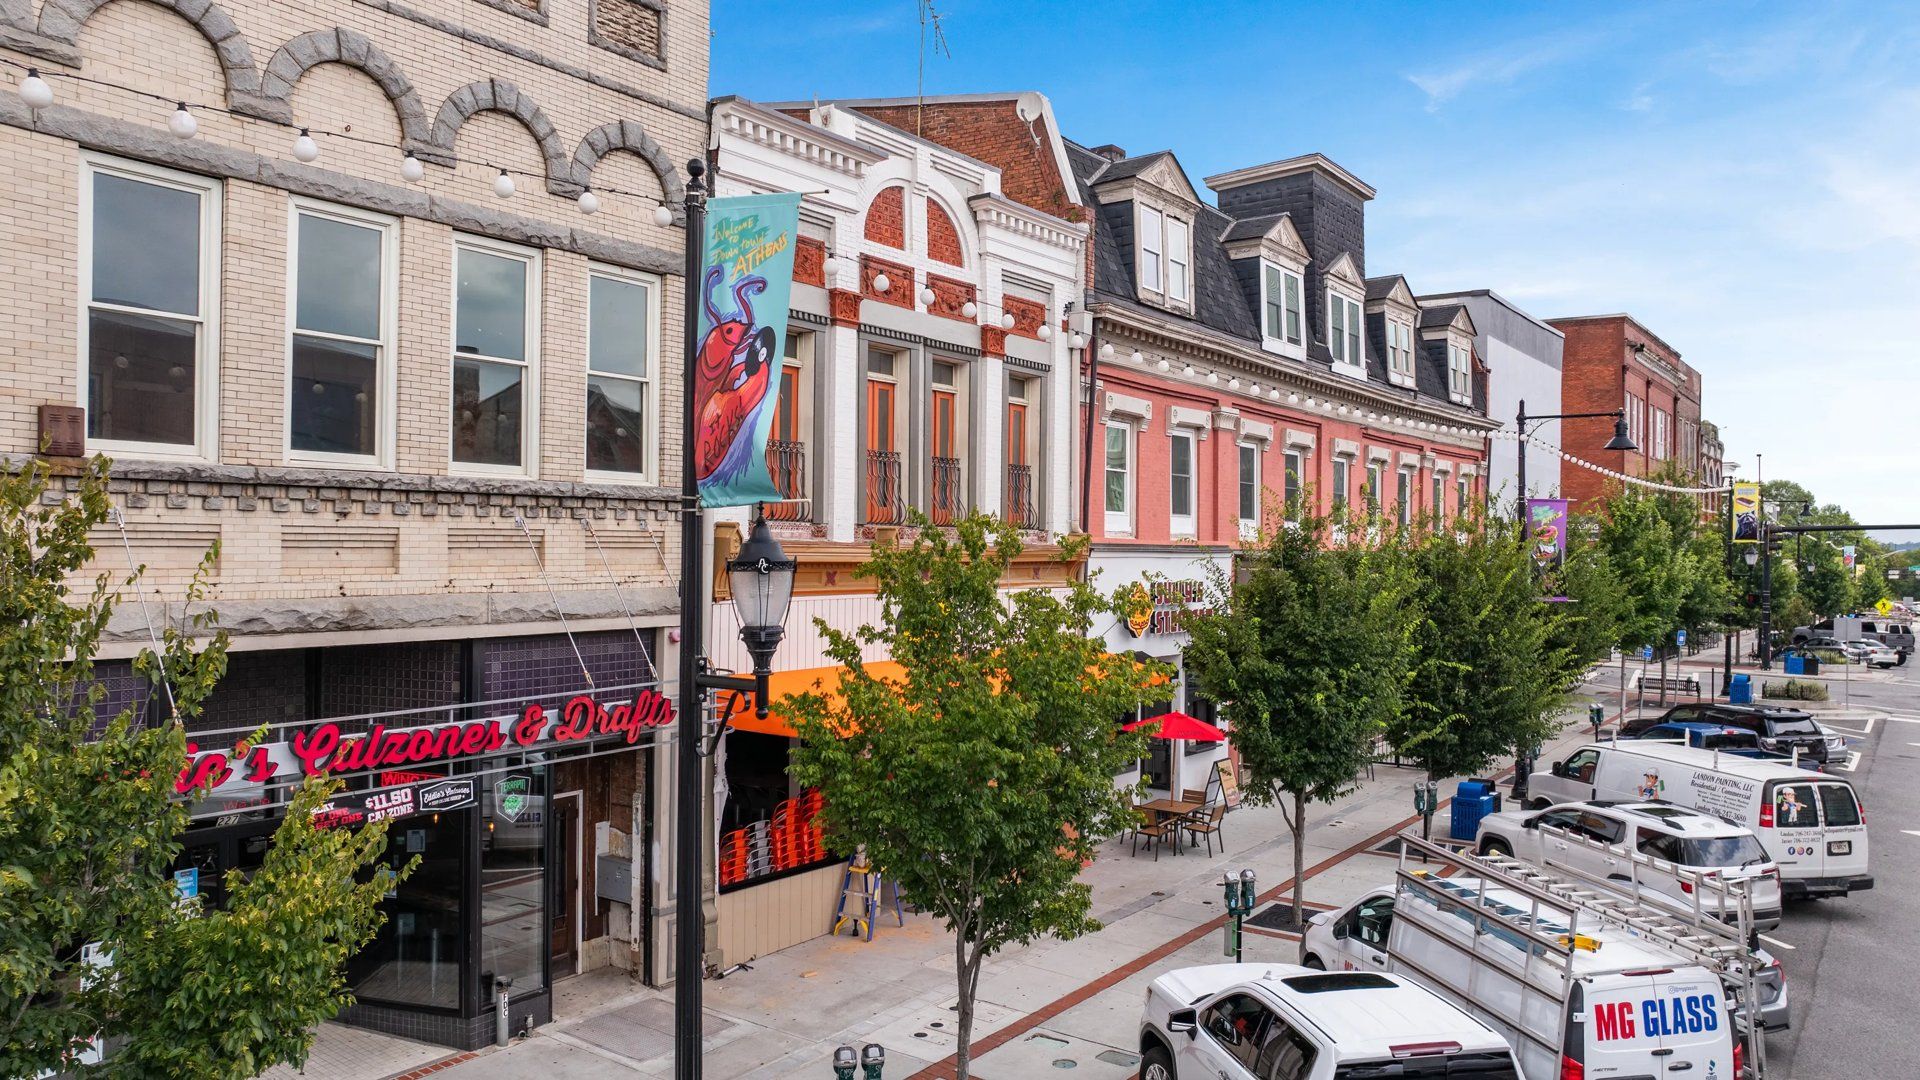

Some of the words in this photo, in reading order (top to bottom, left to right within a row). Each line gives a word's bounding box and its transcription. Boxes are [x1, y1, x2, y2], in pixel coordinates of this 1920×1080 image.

[730, 229, 788, 282] ATHENS
[291, 720, 508, 777] Calzones
[513, 703, 548, 746] &
[554, 689, 678, 744] Drafts
[1690, 779, 1717, 792] Residential
[1721, 786, 1752, 801] Commercial
[1693, 771, 1715, 783] LANDON
[1743, 783, 1755, 793] LLC
[365, 788, 414, 811] $11.50
[217, 815, 239, 827] 227
[1594, 1001, 1636, 1042] MG
[1642, 994, 1718, 1038] GLASS
